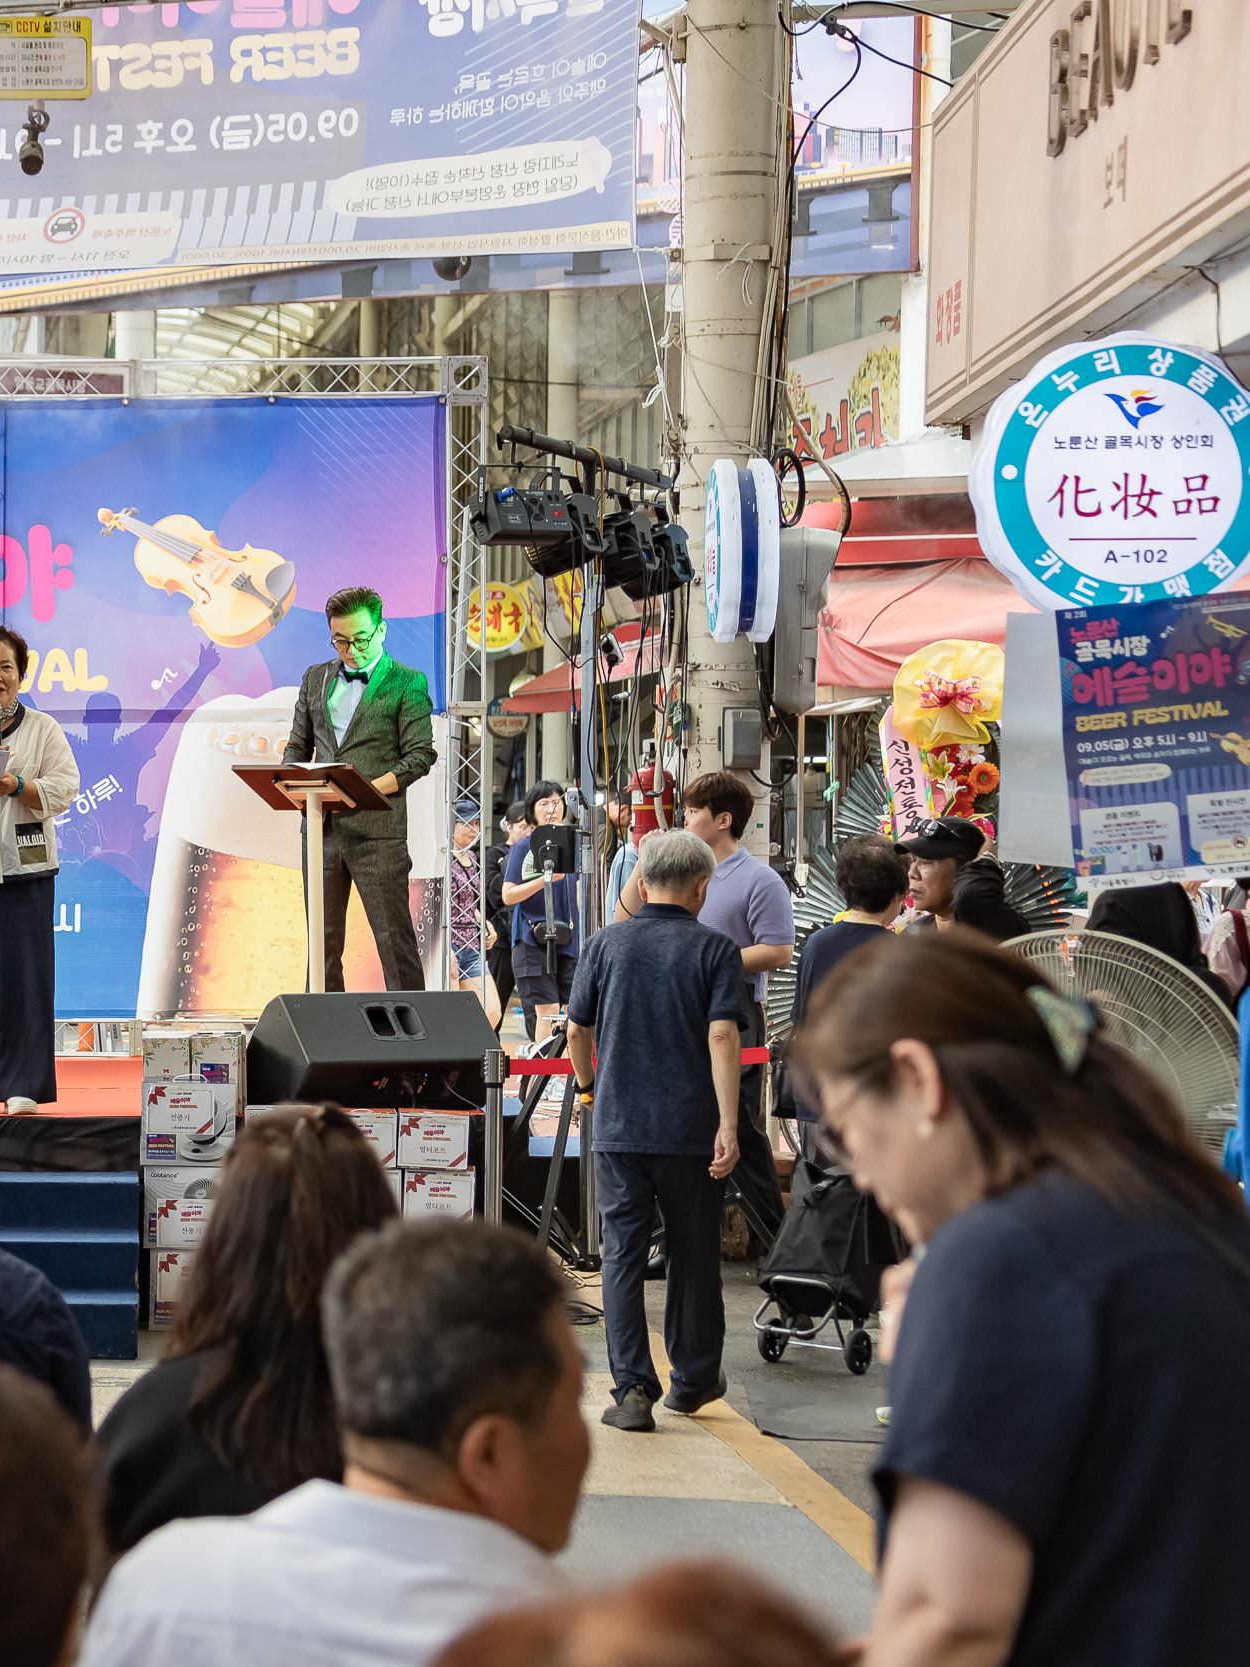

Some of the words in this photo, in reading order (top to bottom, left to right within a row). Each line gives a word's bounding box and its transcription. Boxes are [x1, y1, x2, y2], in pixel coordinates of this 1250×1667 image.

[16, 21, 40, 33] CCTV
[43, 20, 81, 33] 설치안내
[1054, 435, 1099, 450] 노룬산
[1105, 435, 1164, 450] 골목시장
[1170, 434, 1214, 450] 상인회
[1104, 549, 1168, 564] A-102
[1070, 617, 1121, 643] 노룬산
[1075, 635, 1150, 662] 골목시장
[1071, 646, 1232, 707] 예술이야
[1075, 711, 1128, 733] BEER
[1131, 700, 1230, 727] FESTIVAL
[1075, 738, 1130, 754] 09.05(금)
[1132, 736, 1155, 749] 오후
[73, 774, 124, 815] 하루!
[170, 1113, 190, 1122] 선풍기
